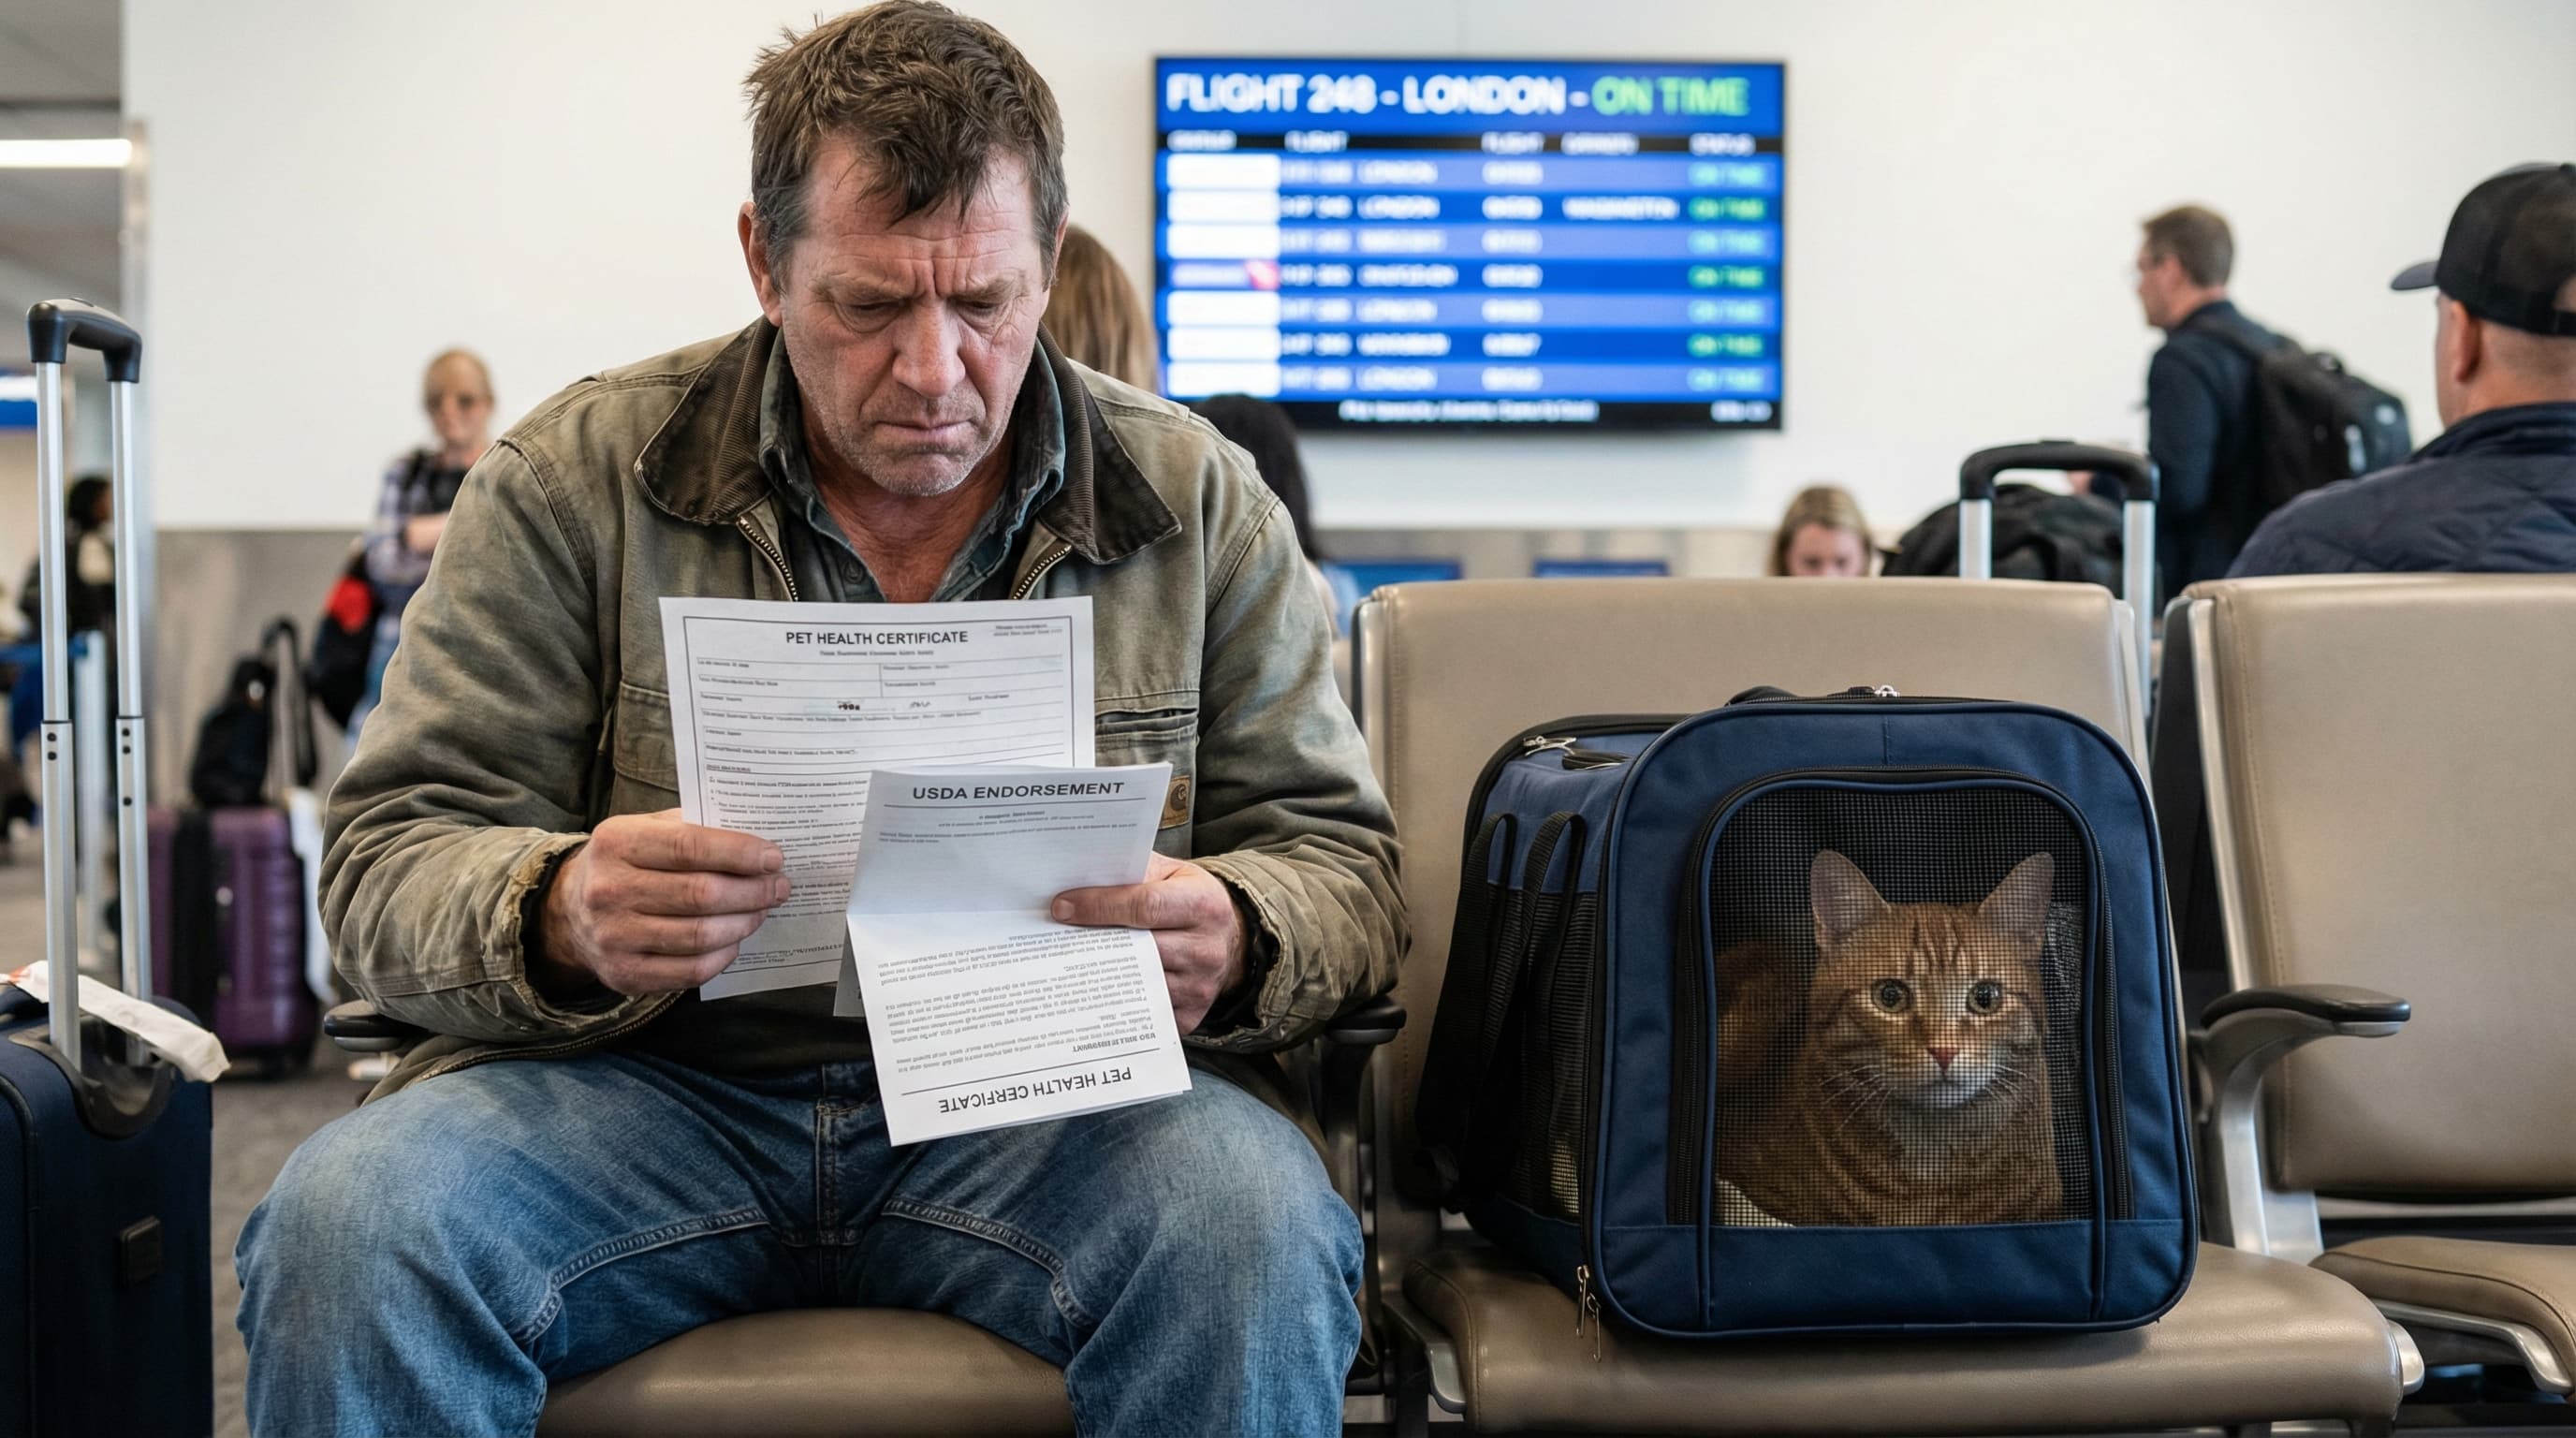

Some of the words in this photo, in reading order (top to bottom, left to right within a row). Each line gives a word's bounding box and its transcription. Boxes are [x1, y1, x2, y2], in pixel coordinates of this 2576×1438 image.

[1167, 73, 1304, 112] FLIGHT
[1403, 75, 1566, 114] LONDON
[1593, 76, 1652, 115] ON
[1658, 77, 1749, 116] TIME
[786, 632, 812, 644] PET
[817, 633, 872, 645] HEALTH
[876, 631, 969, 644] CERTIFICATE
[913, 786, 968, 800] USDA
[973, 782, 1125, 799] ENDORSEMENT
[1033, 1073, 1096, 1097] HEALTH
[1101, 1066, 1133, 1085] PET
[938, 1085, 1029, 1113] CERFICATE
